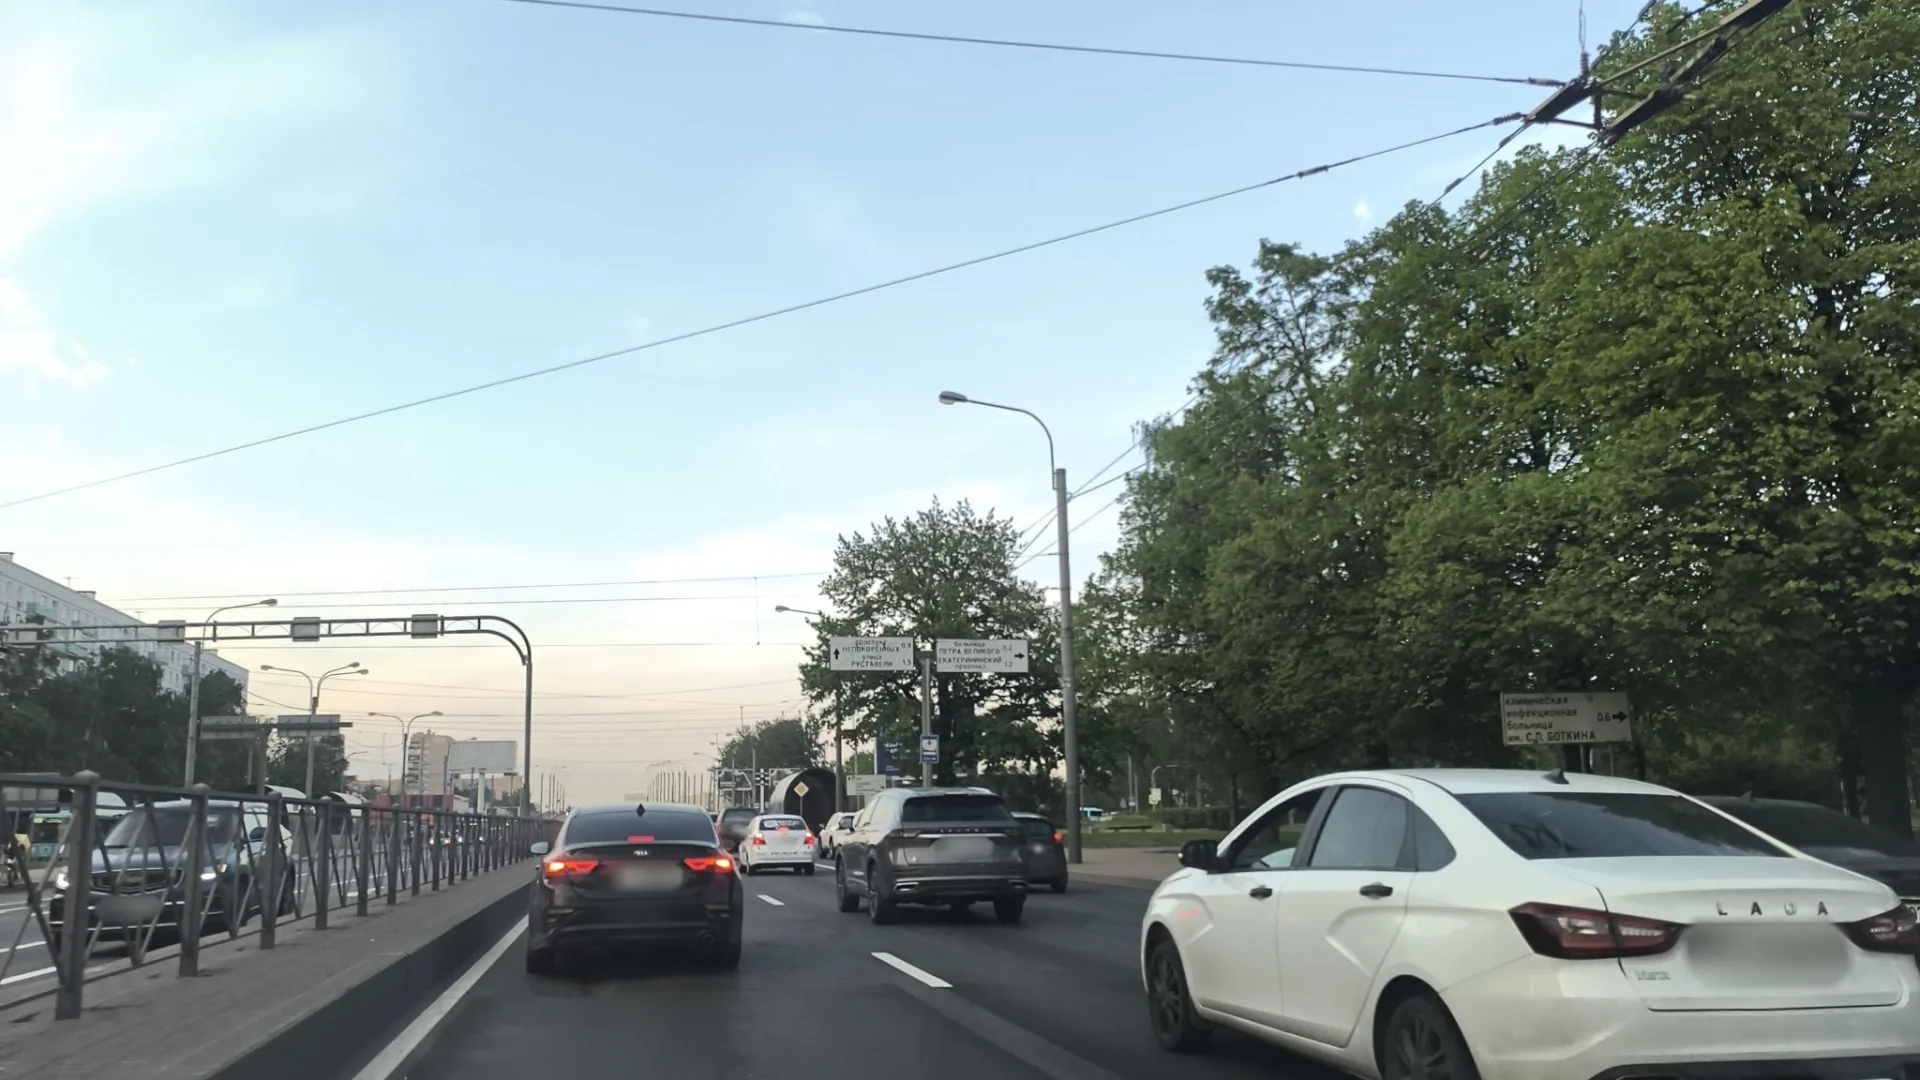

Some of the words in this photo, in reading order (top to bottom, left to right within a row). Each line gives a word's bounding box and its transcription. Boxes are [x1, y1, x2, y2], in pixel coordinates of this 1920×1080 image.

[1506, 708, 1577, 720] инфекционная
[1597, 712, 1611, 722] 0.6
[1508, 735, 1523, 743] им.
[1548, 731, 1596, 742] БОТКИНА
[1717, 901, 1829, 916] LADA
